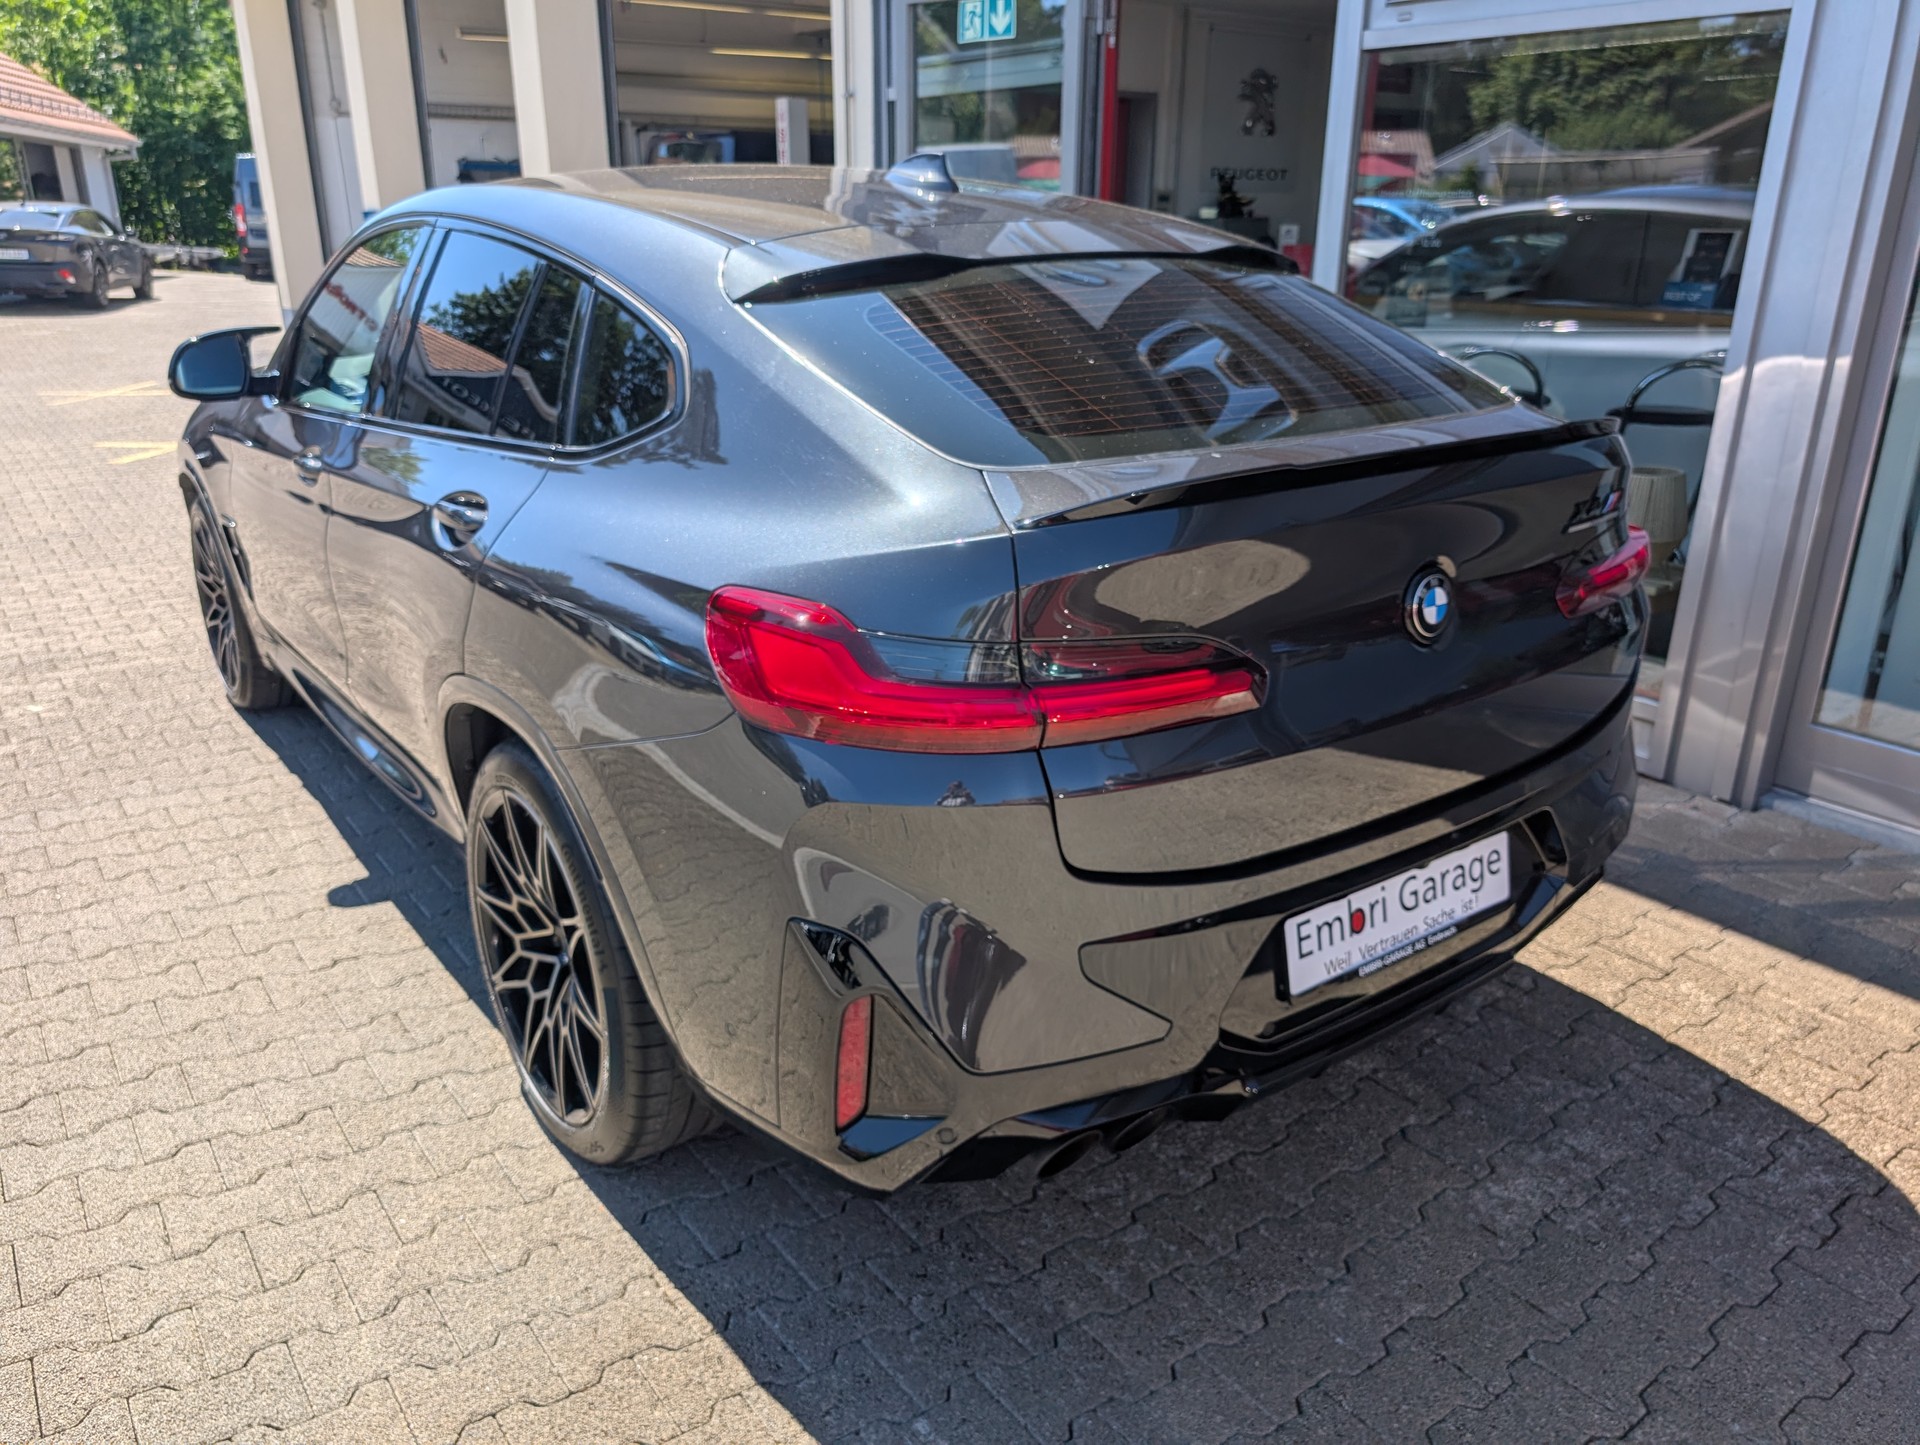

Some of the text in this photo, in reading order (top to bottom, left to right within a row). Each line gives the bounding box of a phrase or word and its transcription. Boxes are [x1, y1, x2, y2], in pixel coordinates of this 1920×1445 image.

[1210, 168, 1288, 181] PEUGEOT
[1297, 848, 1501, 959] Embri Garage
[1358, 925, 1418, 960] Vertrauen
[1423, 908, 1455, 931] Sache
